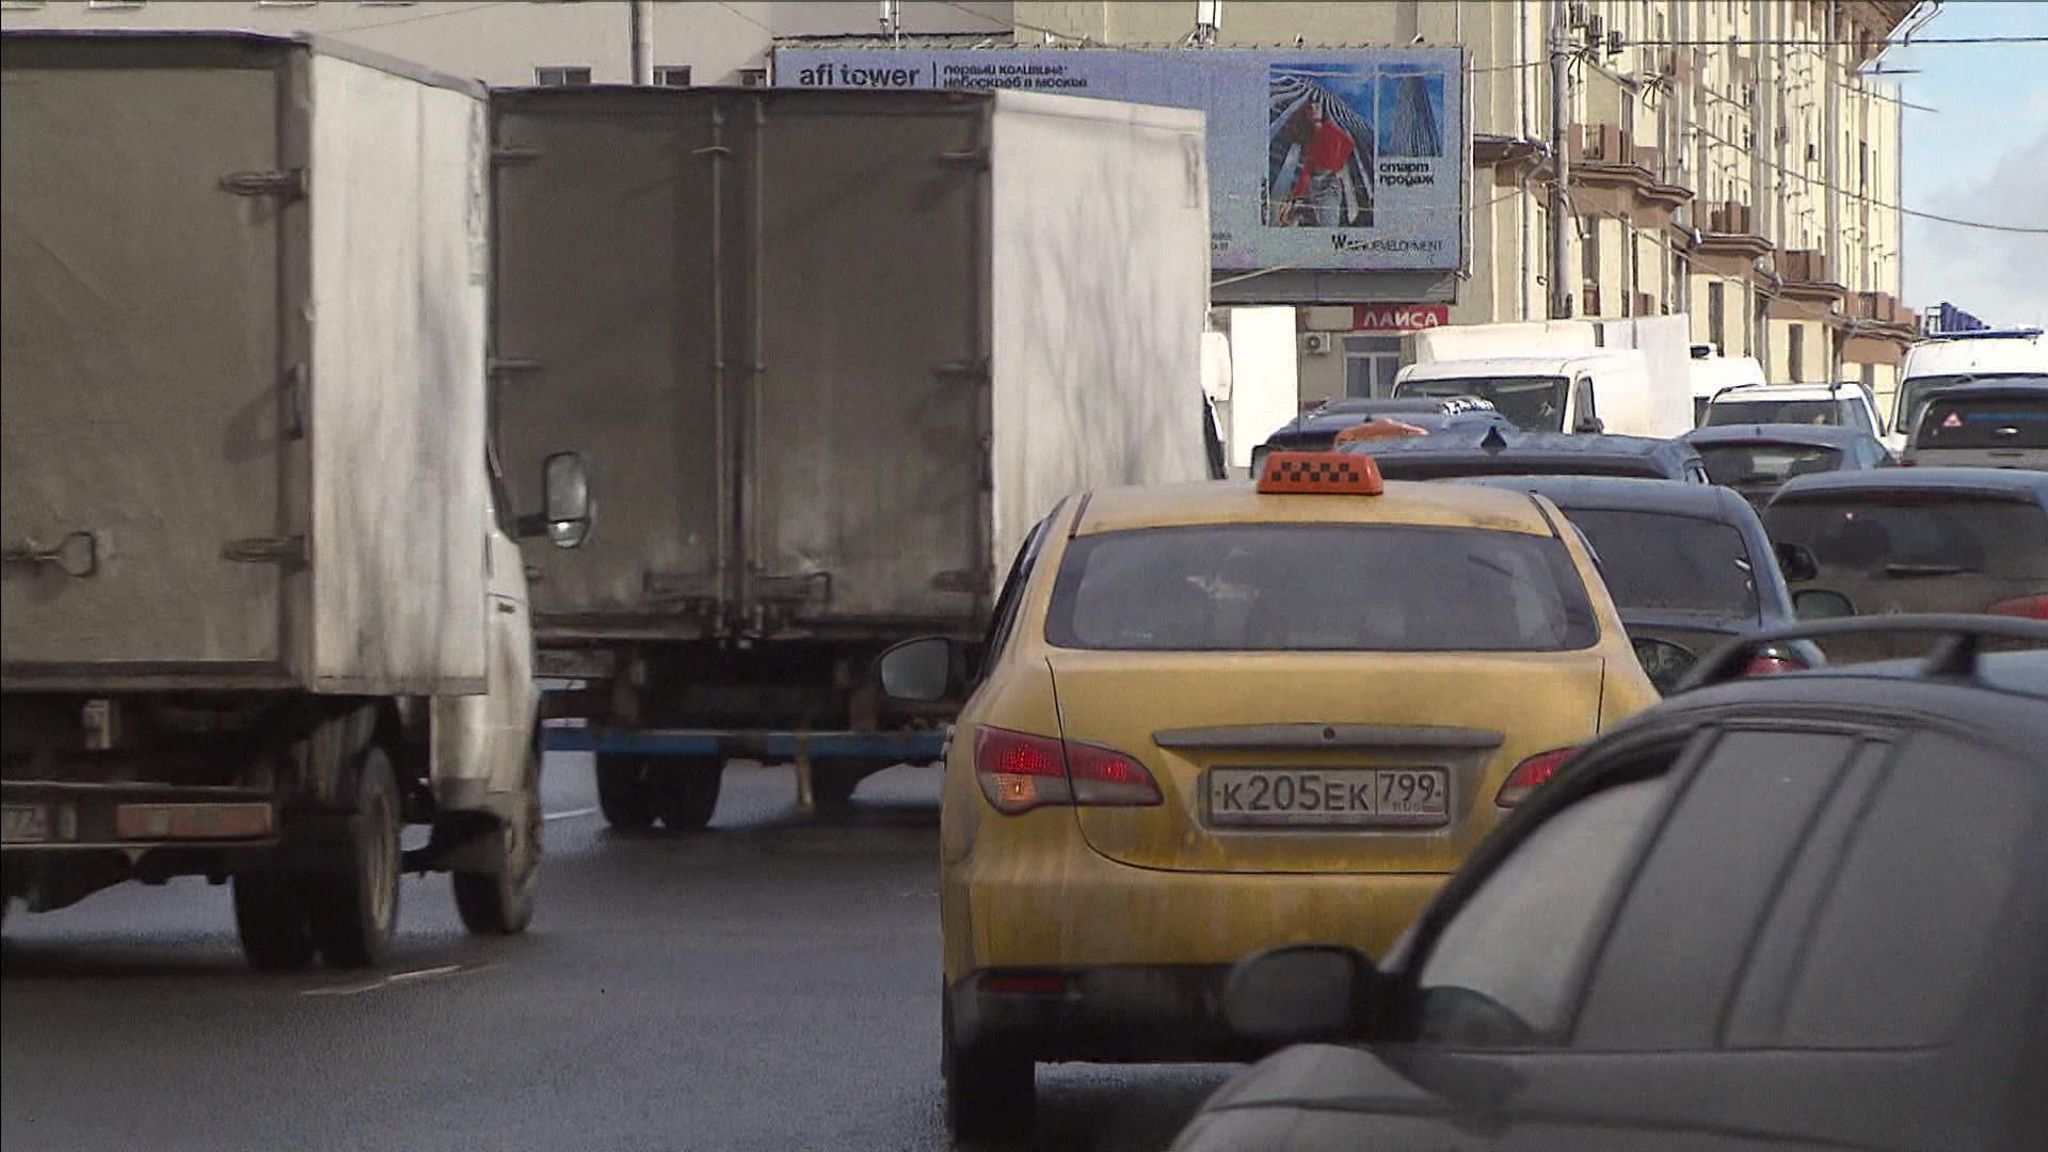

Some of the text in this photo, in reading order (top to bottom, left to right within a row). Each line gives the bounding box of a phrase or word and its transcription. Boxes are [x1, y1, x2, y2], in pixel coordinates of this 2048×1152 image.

[799, 63, 921, 87] afi tower
[1379, 162, 1430, 174] старт
[1379, 173, 1435, 187] продаж
[1379, 773, 1436, 803] 799
